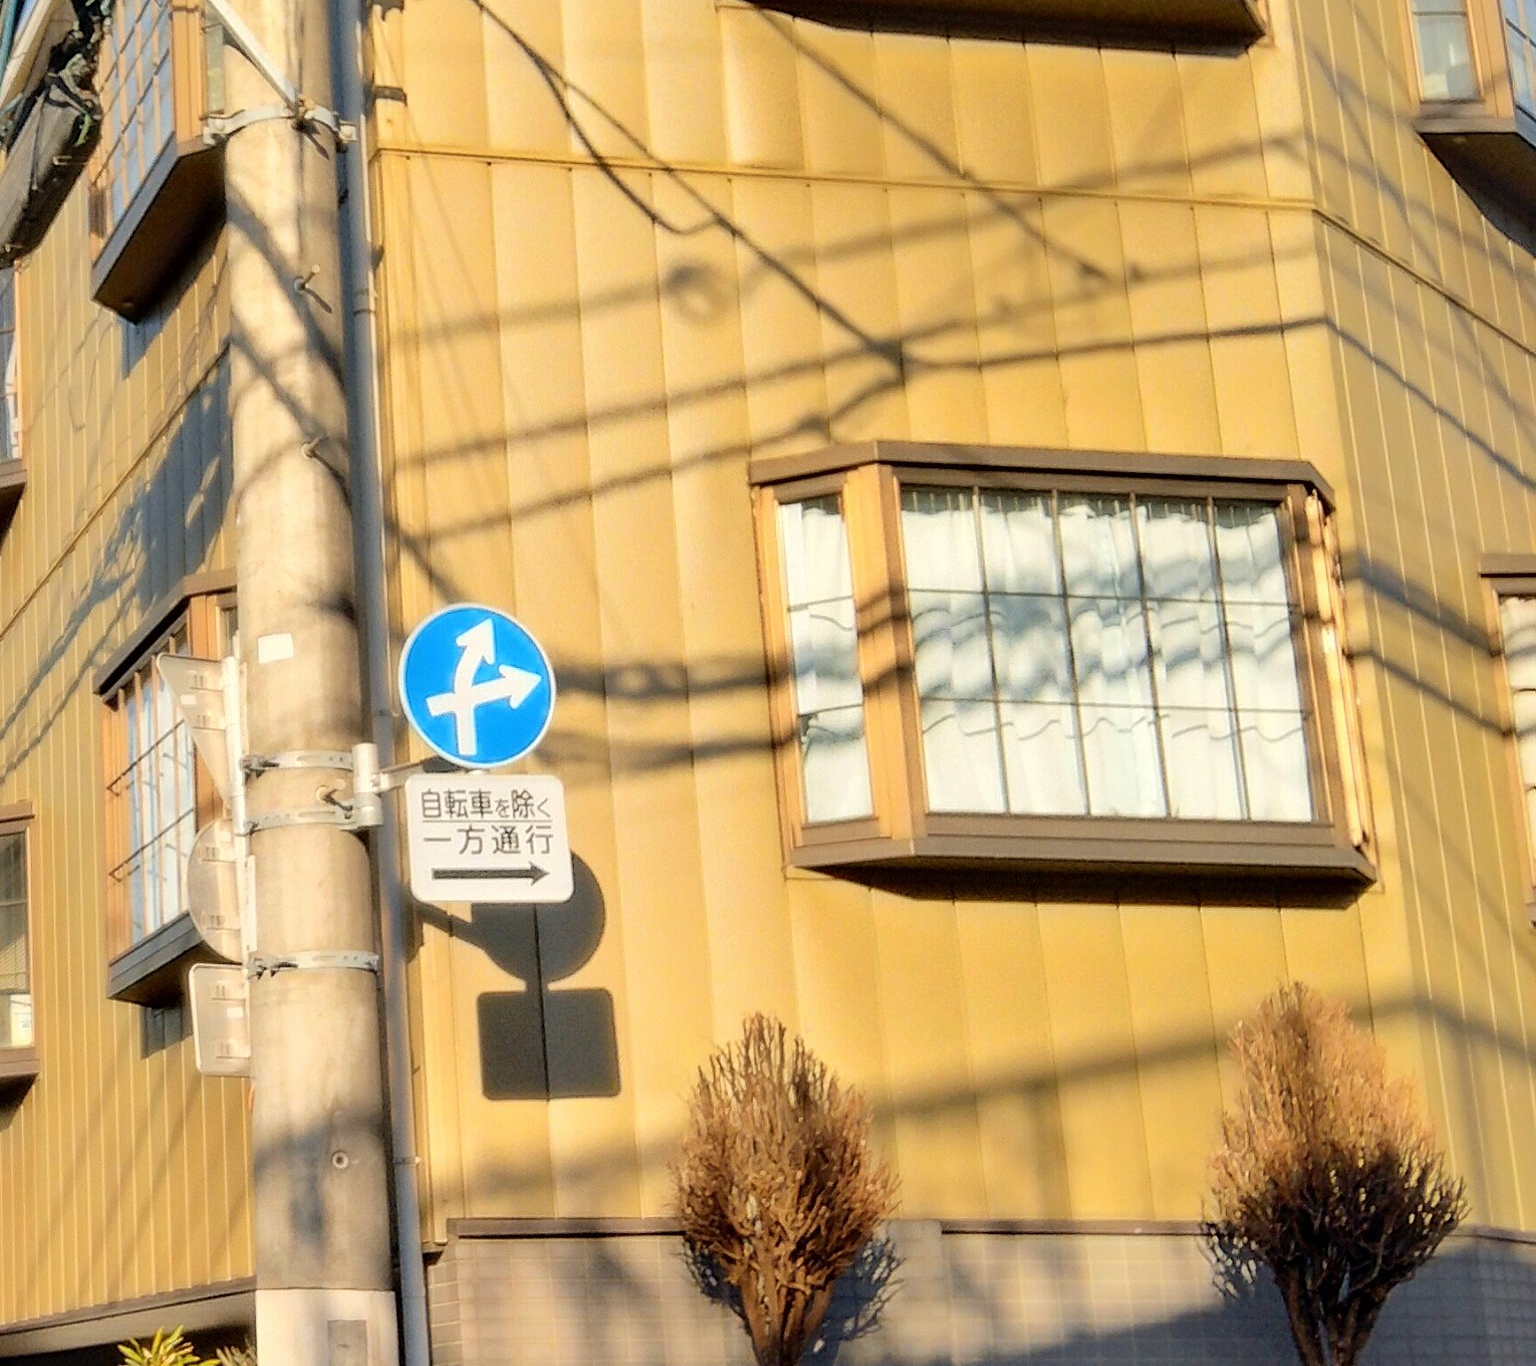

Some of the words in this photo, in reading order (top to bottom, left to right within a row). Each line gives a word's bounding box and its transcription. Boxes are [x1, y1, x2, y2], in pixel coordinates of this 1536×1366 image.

[421, 788, 552, 819] 自転車を除く
[423, 823, 553, 855] 一方通行
